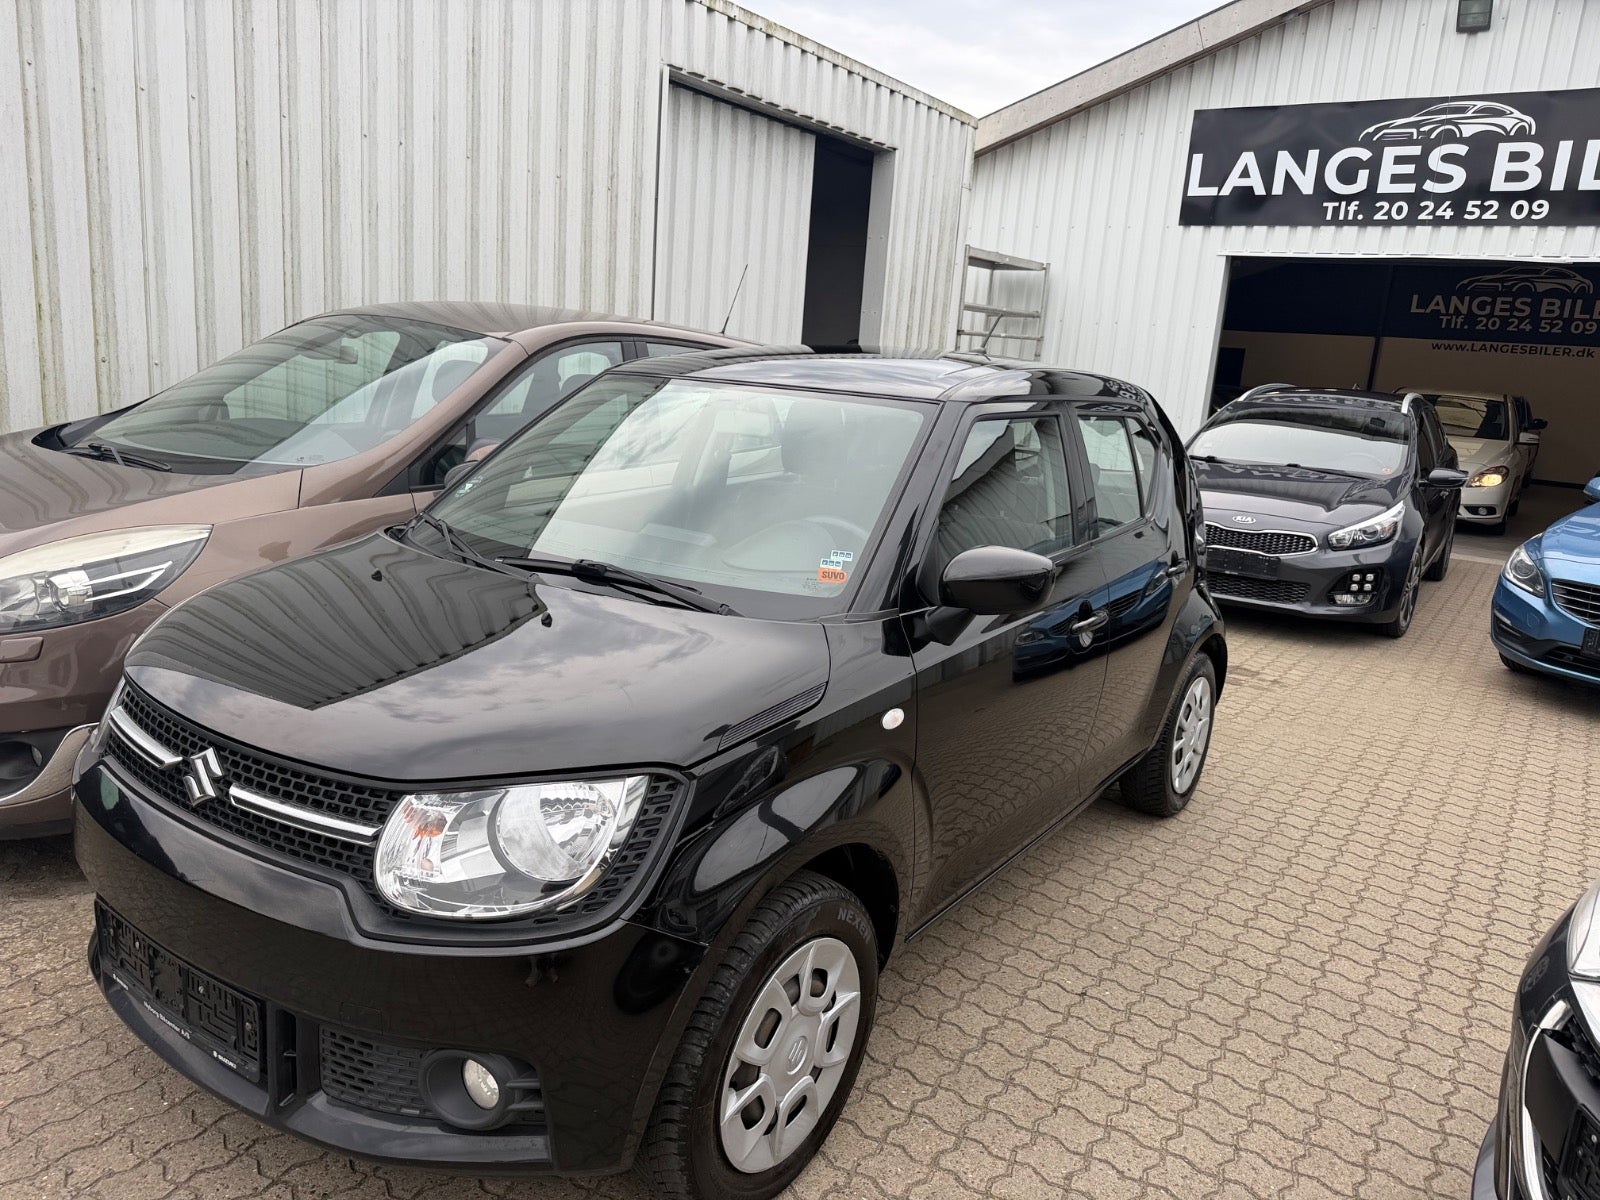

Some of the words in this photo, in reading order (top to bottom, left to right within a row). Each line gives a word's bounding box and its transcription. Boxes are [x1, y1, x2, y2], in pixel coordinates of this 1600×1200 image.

[1187, 143, 1469, 197] LANGES
[1322, 201, 1364, 221] Tlf.
[1373, 201, 1409, 221] 20
[1417, 200, 1454, 220] 24
[1463, 200, 1500, 220] 52
[1510, 199, 1550, 220] 09
[1410, 294, 1531, 318] LANGES
[1439, 315, 1469, 330] Tlf.
[1475, 316, 1500, 331] 20
[1506, 318, 1533, 333] 24
[1538, 319, 1563, 333] 52
[1570, 320, 1598, 335] 09
[1431, 341, 1596, 359] www.LANGESBILER.dk
[1234, 515, 1253, 523] KIA
